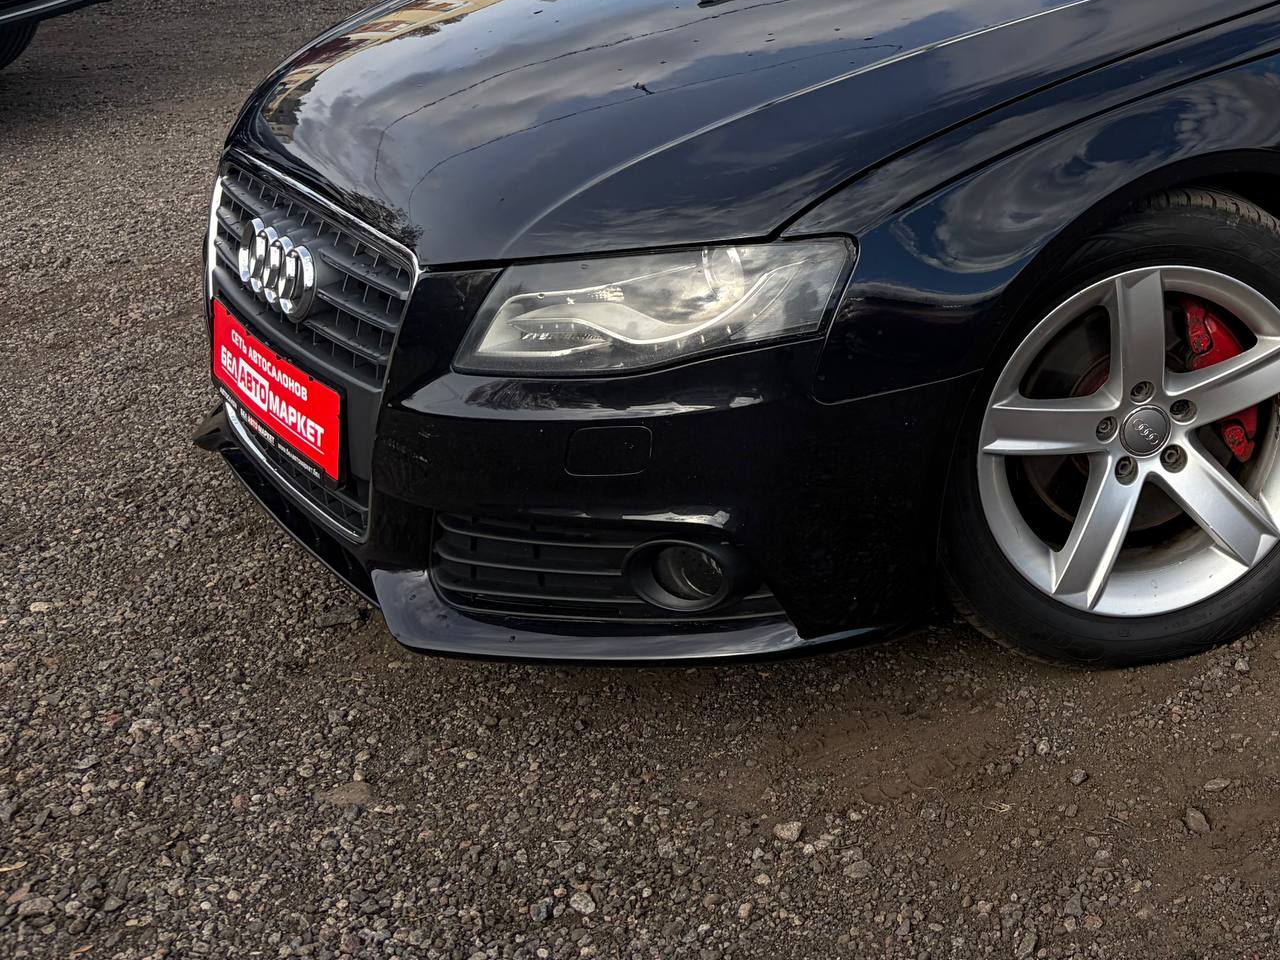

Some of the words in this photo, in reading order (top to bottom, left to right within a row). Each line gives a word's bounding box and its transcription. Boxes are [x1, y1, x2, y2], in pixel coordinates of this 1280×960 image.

[221, 345, 238, 378] БЕЛ
[238, 358, 269, 411] АВТО
[269, 390, 325, 448] МАРКЕТ
[231, 329, 247, 353] СЕТЬ
[248, 346, 308, 401] АВТОСАЛОНОВ
